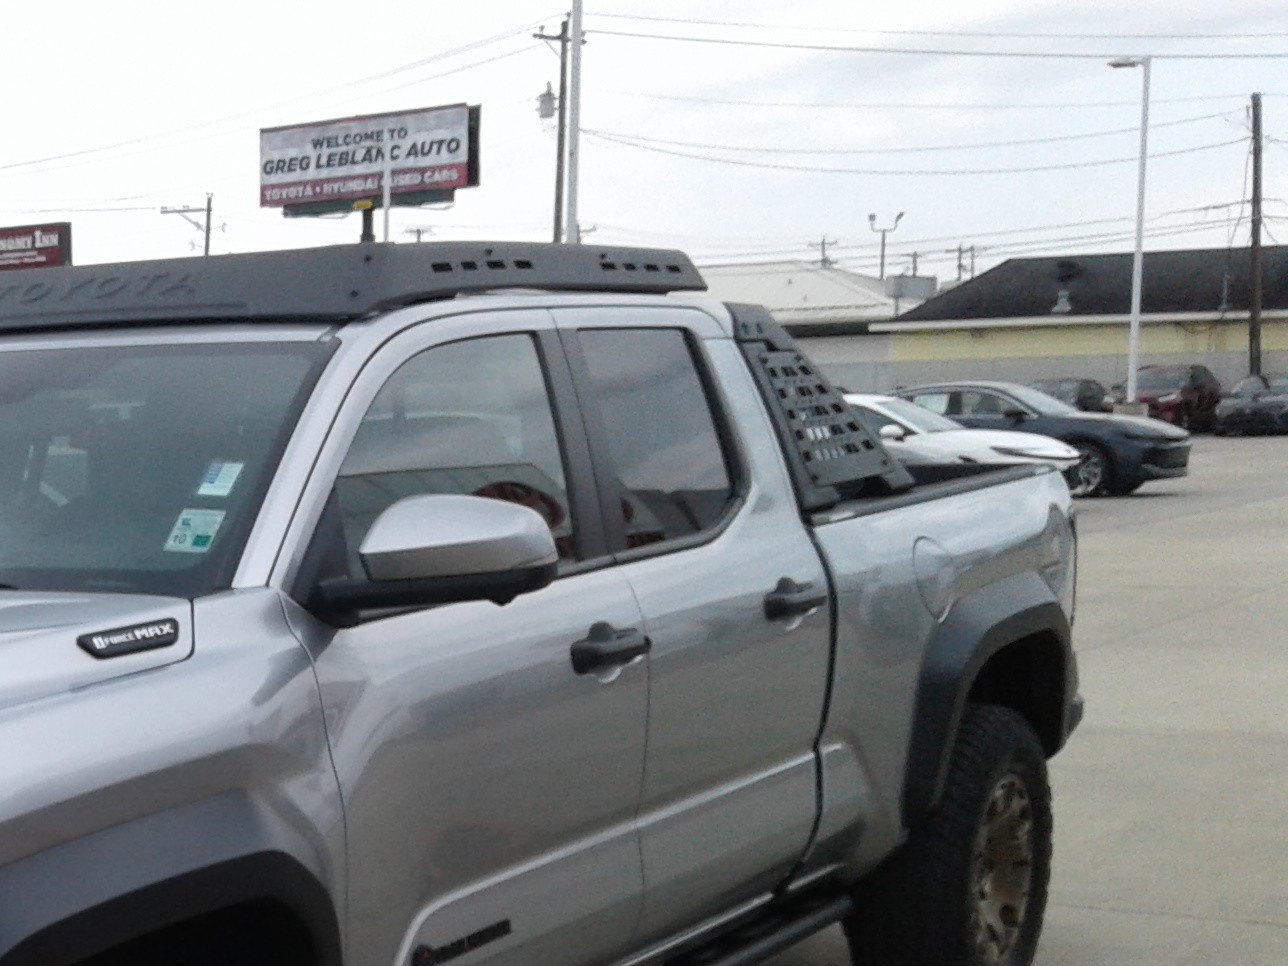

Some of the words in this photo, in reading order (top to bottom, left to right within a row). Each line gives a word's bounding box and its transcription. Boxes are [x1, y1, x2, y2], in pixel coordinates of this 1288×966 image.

[312, 129, 383, 150] WELCOME
[389, 126, 408, 140] TO
[263, 155, 311, 175] GREG
[405, 137, 460, 159] AUTO
